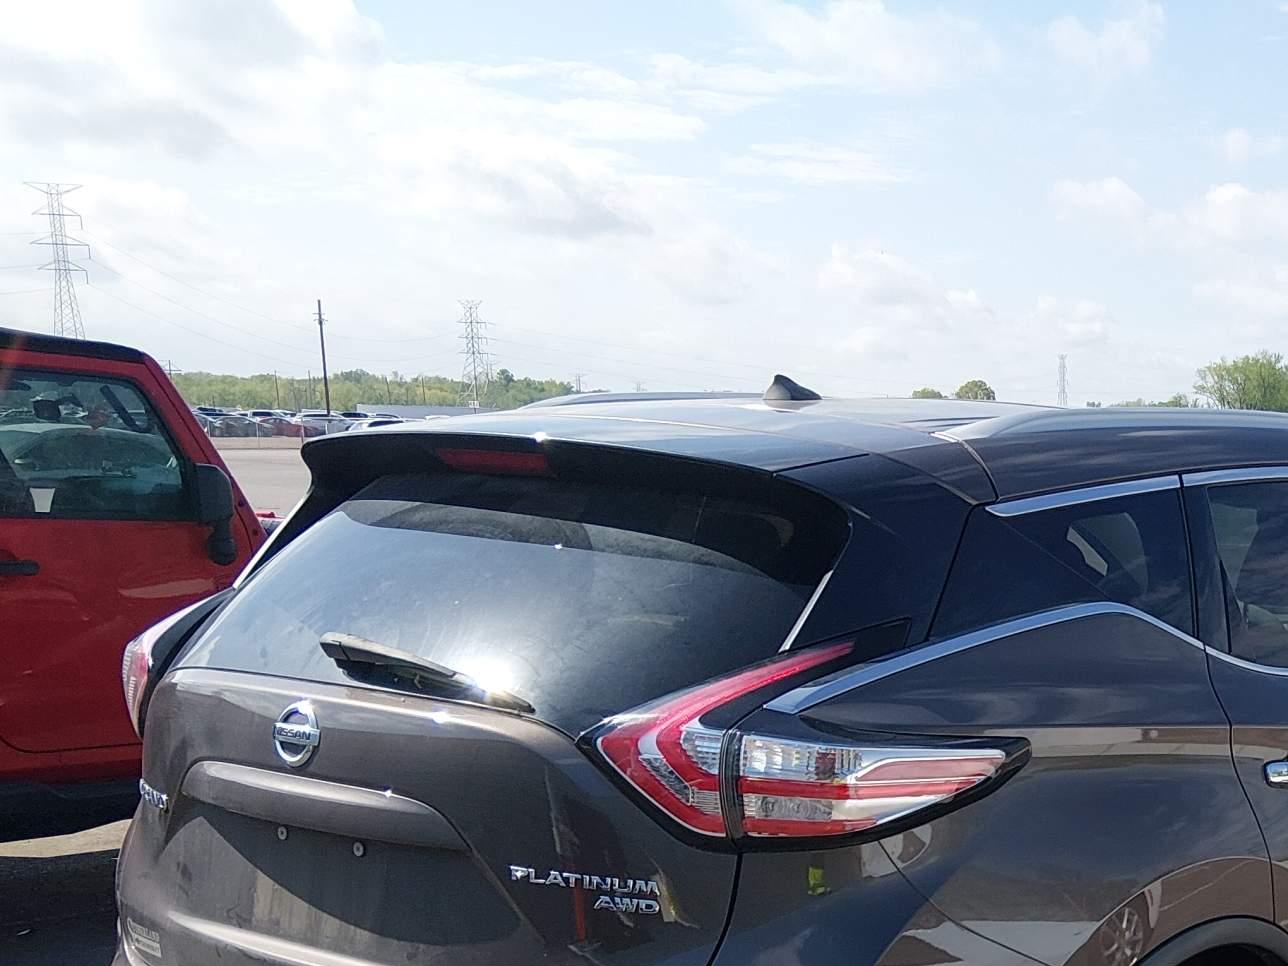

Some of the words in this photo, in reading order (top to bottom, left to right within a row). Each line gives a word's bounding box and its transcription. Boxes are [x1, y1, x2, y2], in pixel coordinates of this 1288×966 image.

[274, 725, 311, 741] NISSAN
[509, 865, 660, 896] PLATINUM
[594, 895, 660, 914] AWD
